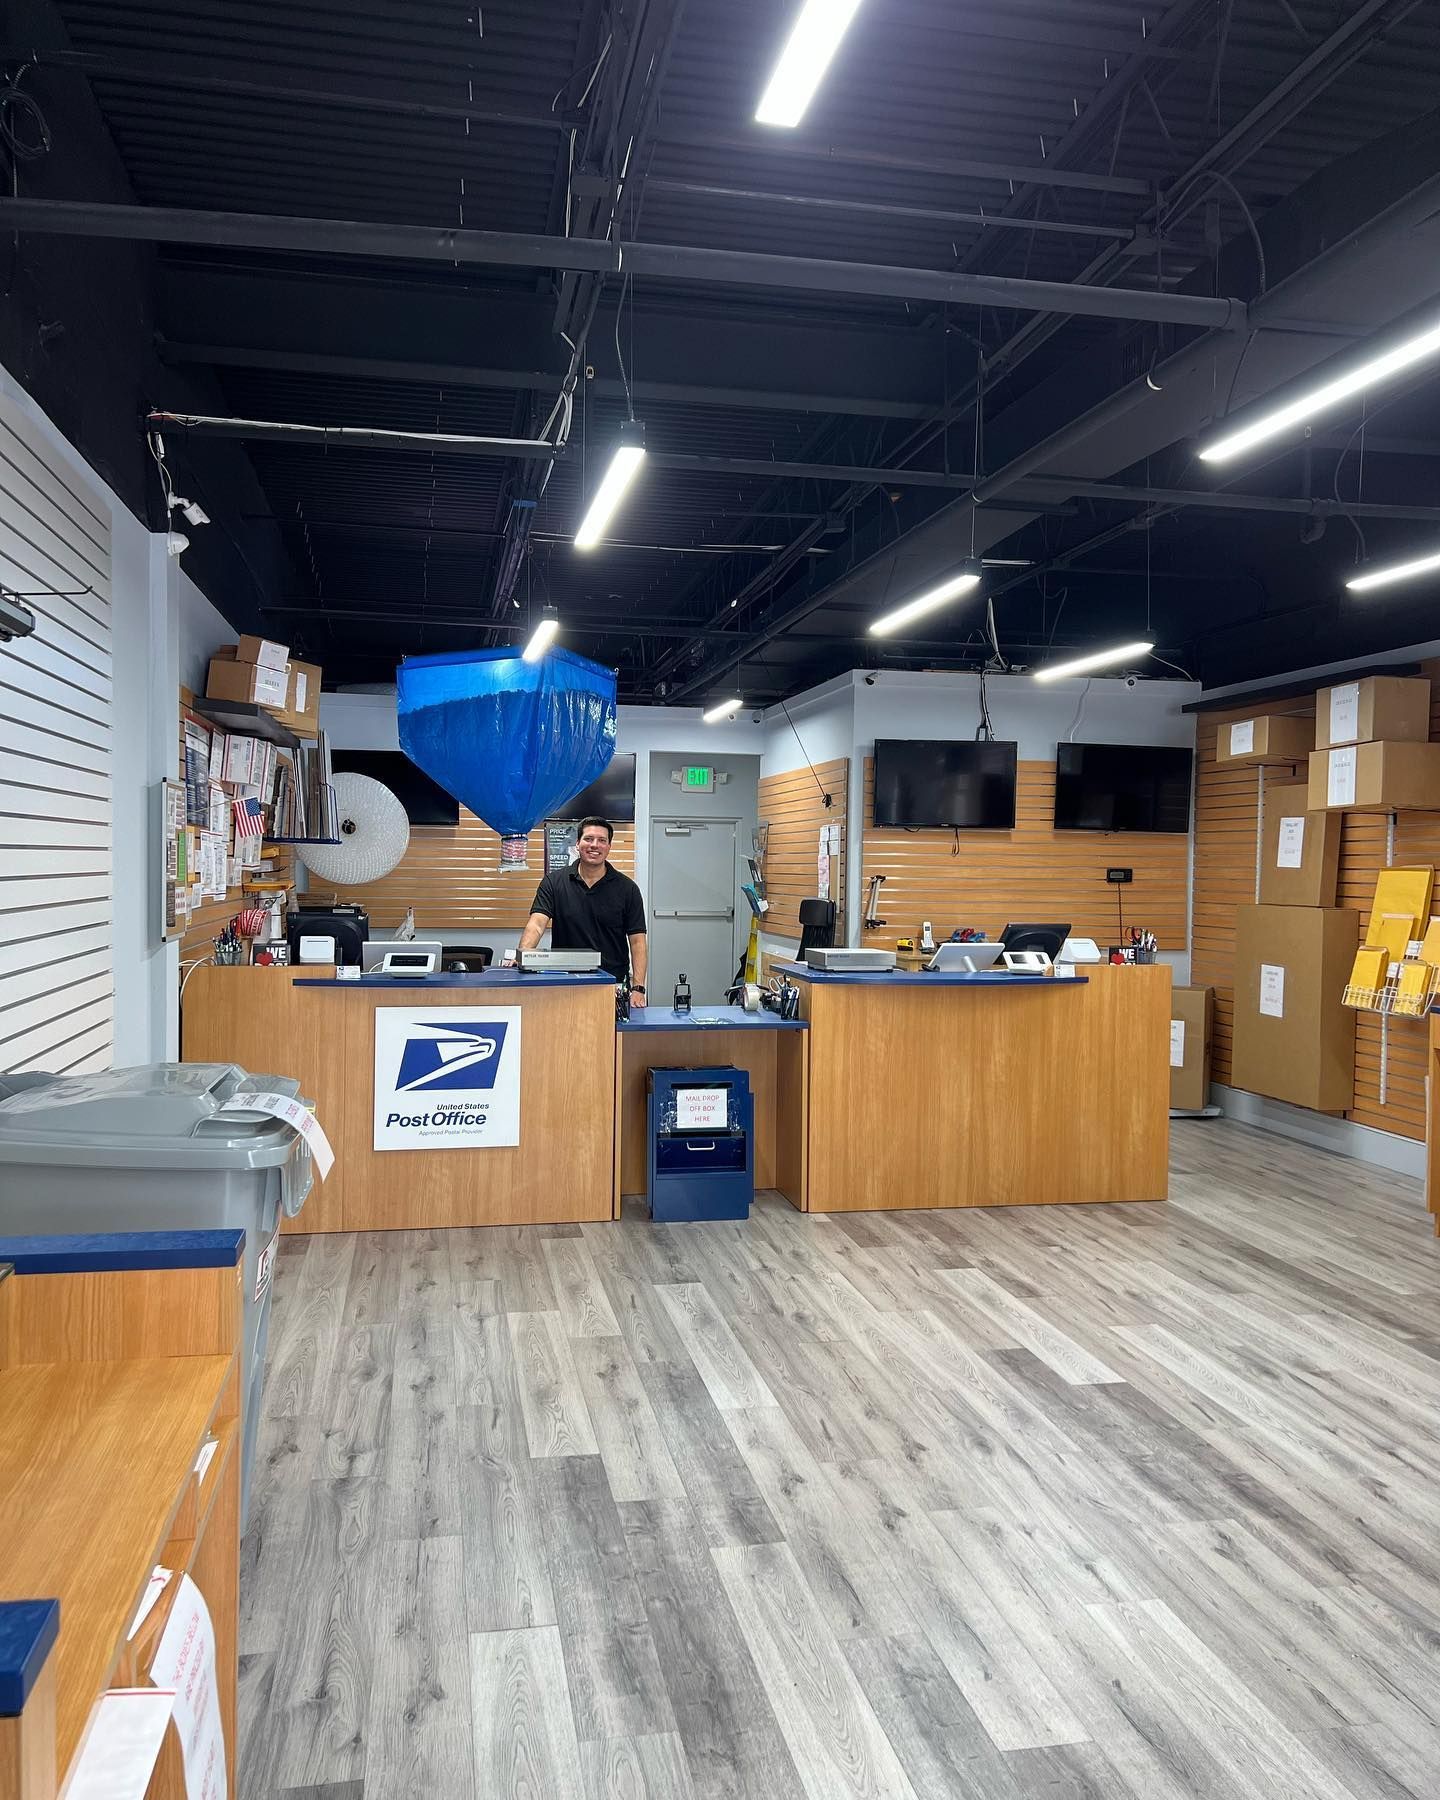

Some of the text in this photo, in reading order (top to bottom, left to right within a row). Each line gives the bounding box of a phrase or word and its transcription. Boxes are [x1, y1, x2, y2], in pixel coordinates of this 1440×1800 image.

[687, 767, 709, 785] EXIT
[266, 947, 286, 959] WE
[1119, 948, 1135, 959] WE
[385, 1111, 487, 1127] Post Office
